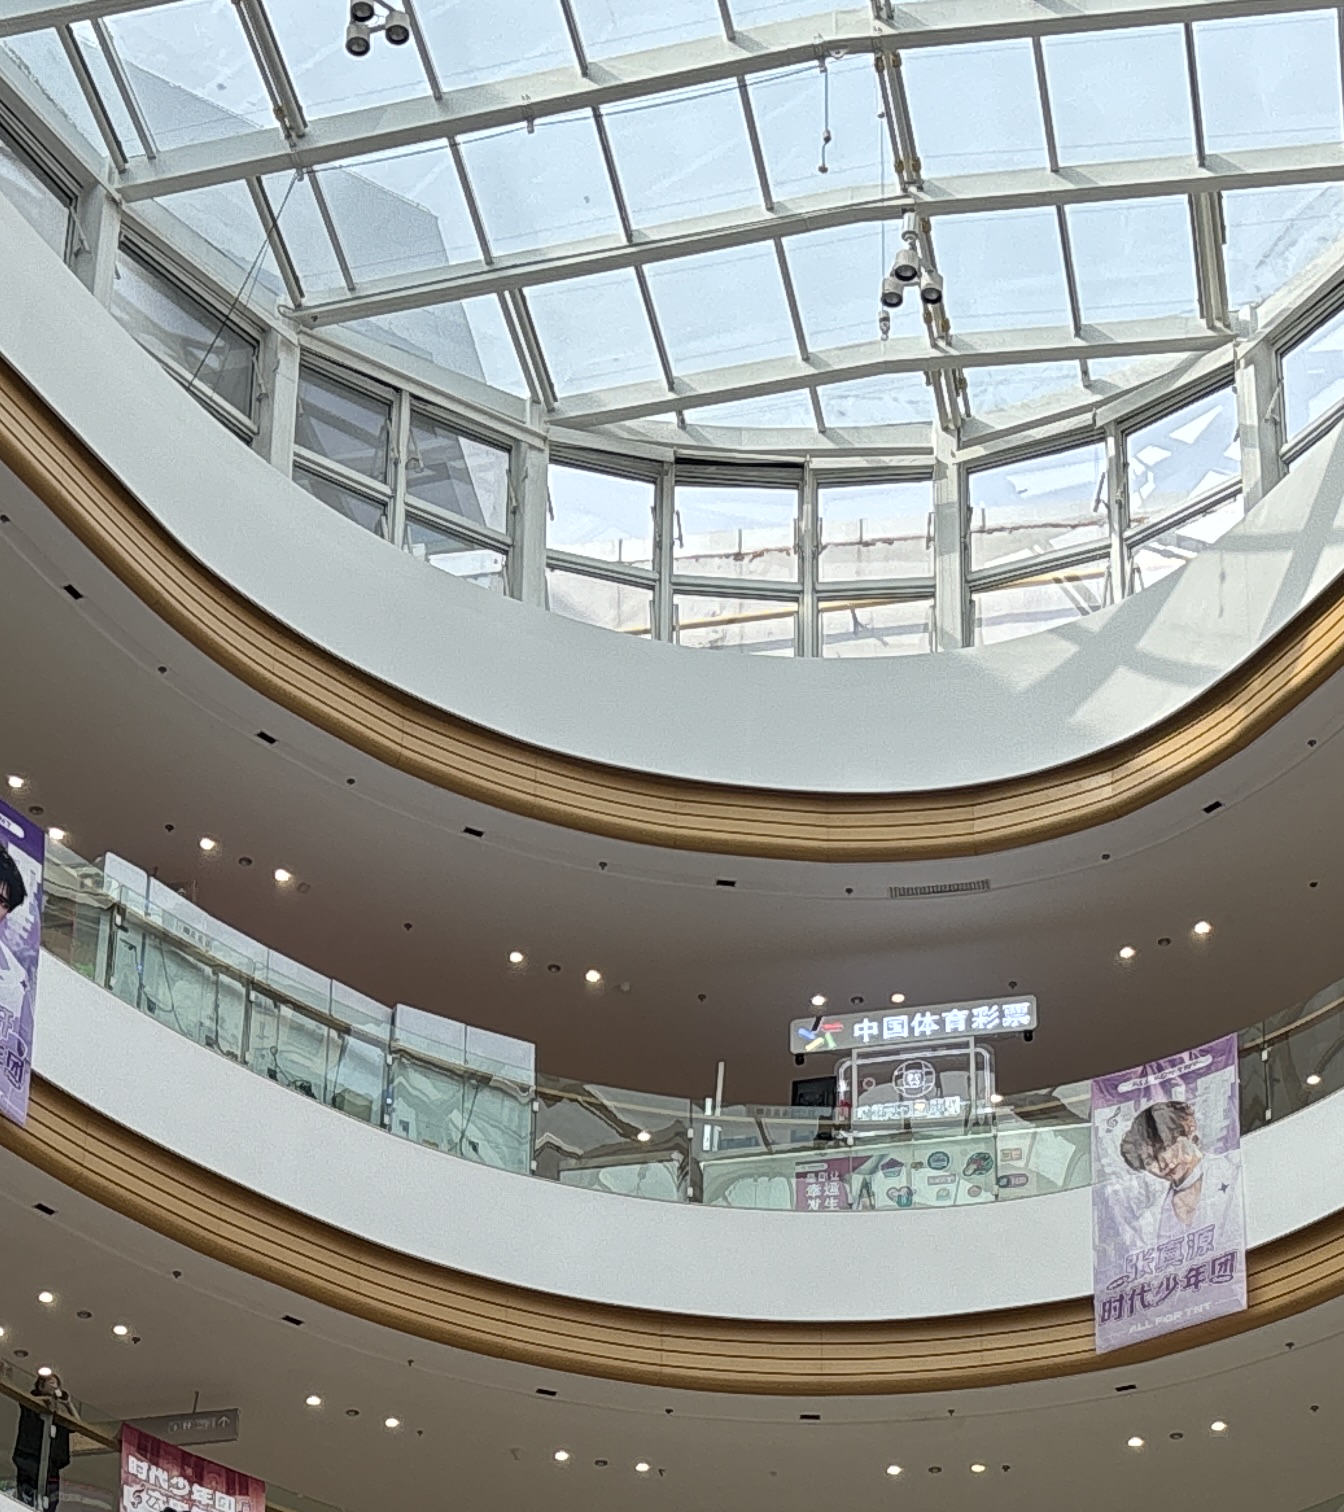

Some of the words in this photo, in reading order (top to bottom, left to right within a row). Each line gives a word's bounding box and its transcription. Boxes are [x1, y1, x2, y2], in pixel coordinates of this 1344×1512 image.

[853, 1001, 1032, 1043] 中国体育彩票
[1102, 1251, 1236, 1323] 时代少年团
